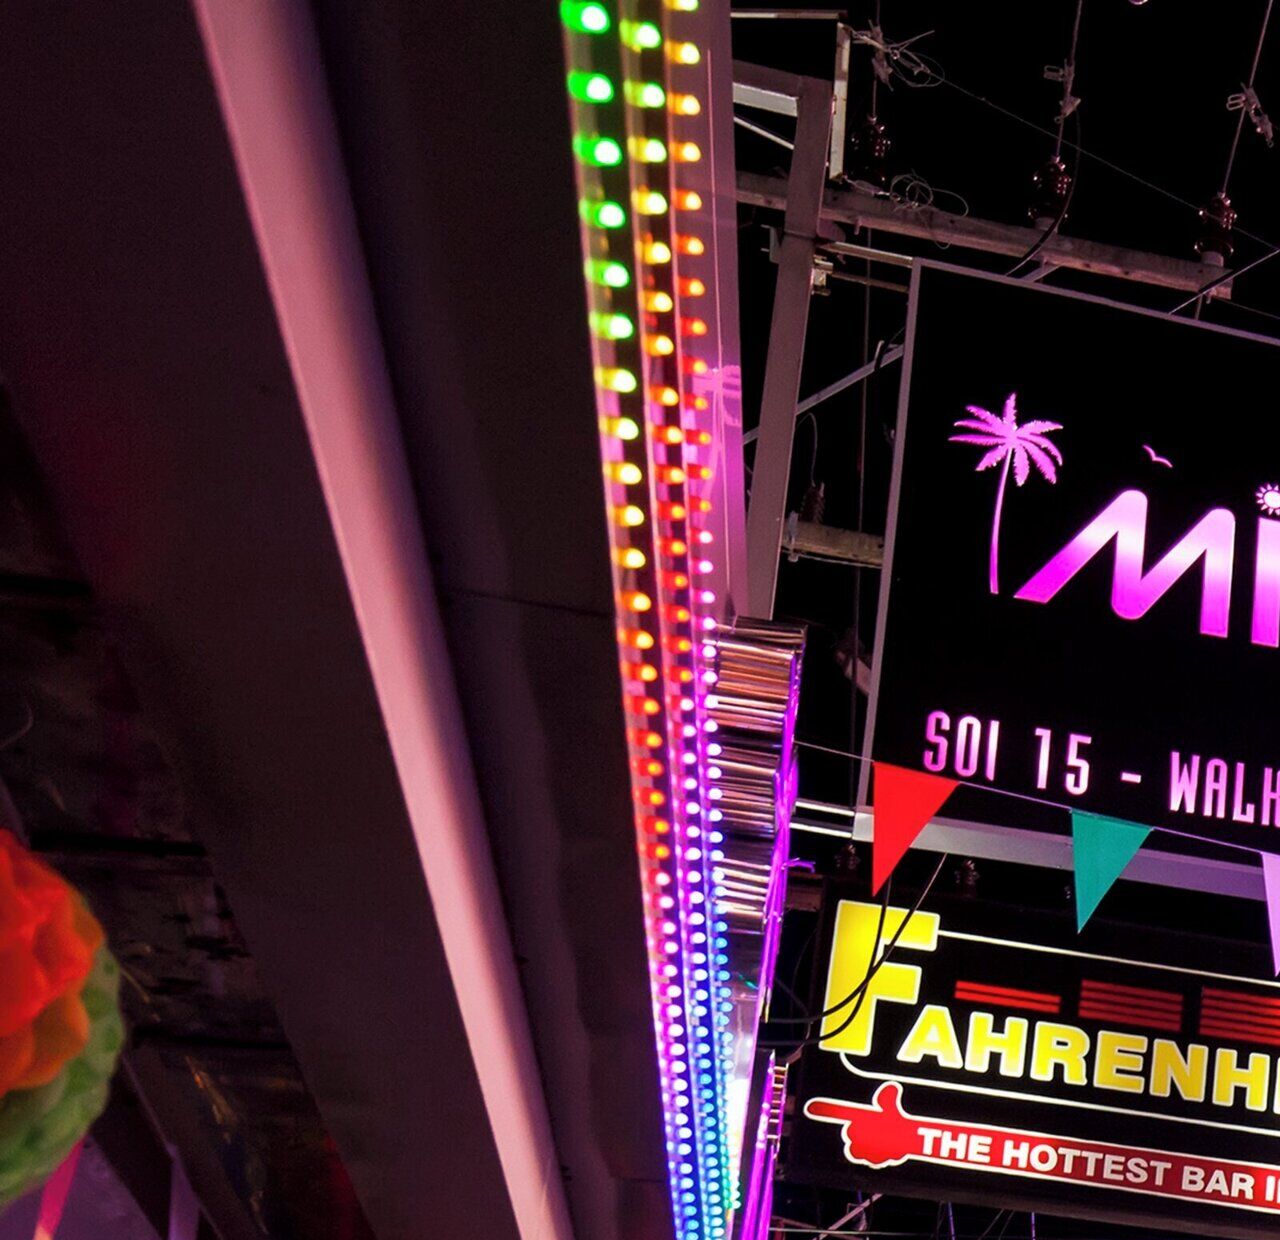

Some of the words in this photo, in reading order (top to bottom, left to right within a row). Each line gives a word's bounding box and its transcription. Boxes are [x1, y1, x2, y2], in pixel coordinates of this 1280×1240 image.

[923, 711, 998, 783] SOI
[1034, 727, 1091, 795] 15
[918, 1127, 992, 1166] THE
[1003, 1132, 1168, 1185] HOTTEST
[1182, 1165, 1255, 1200] BAR
